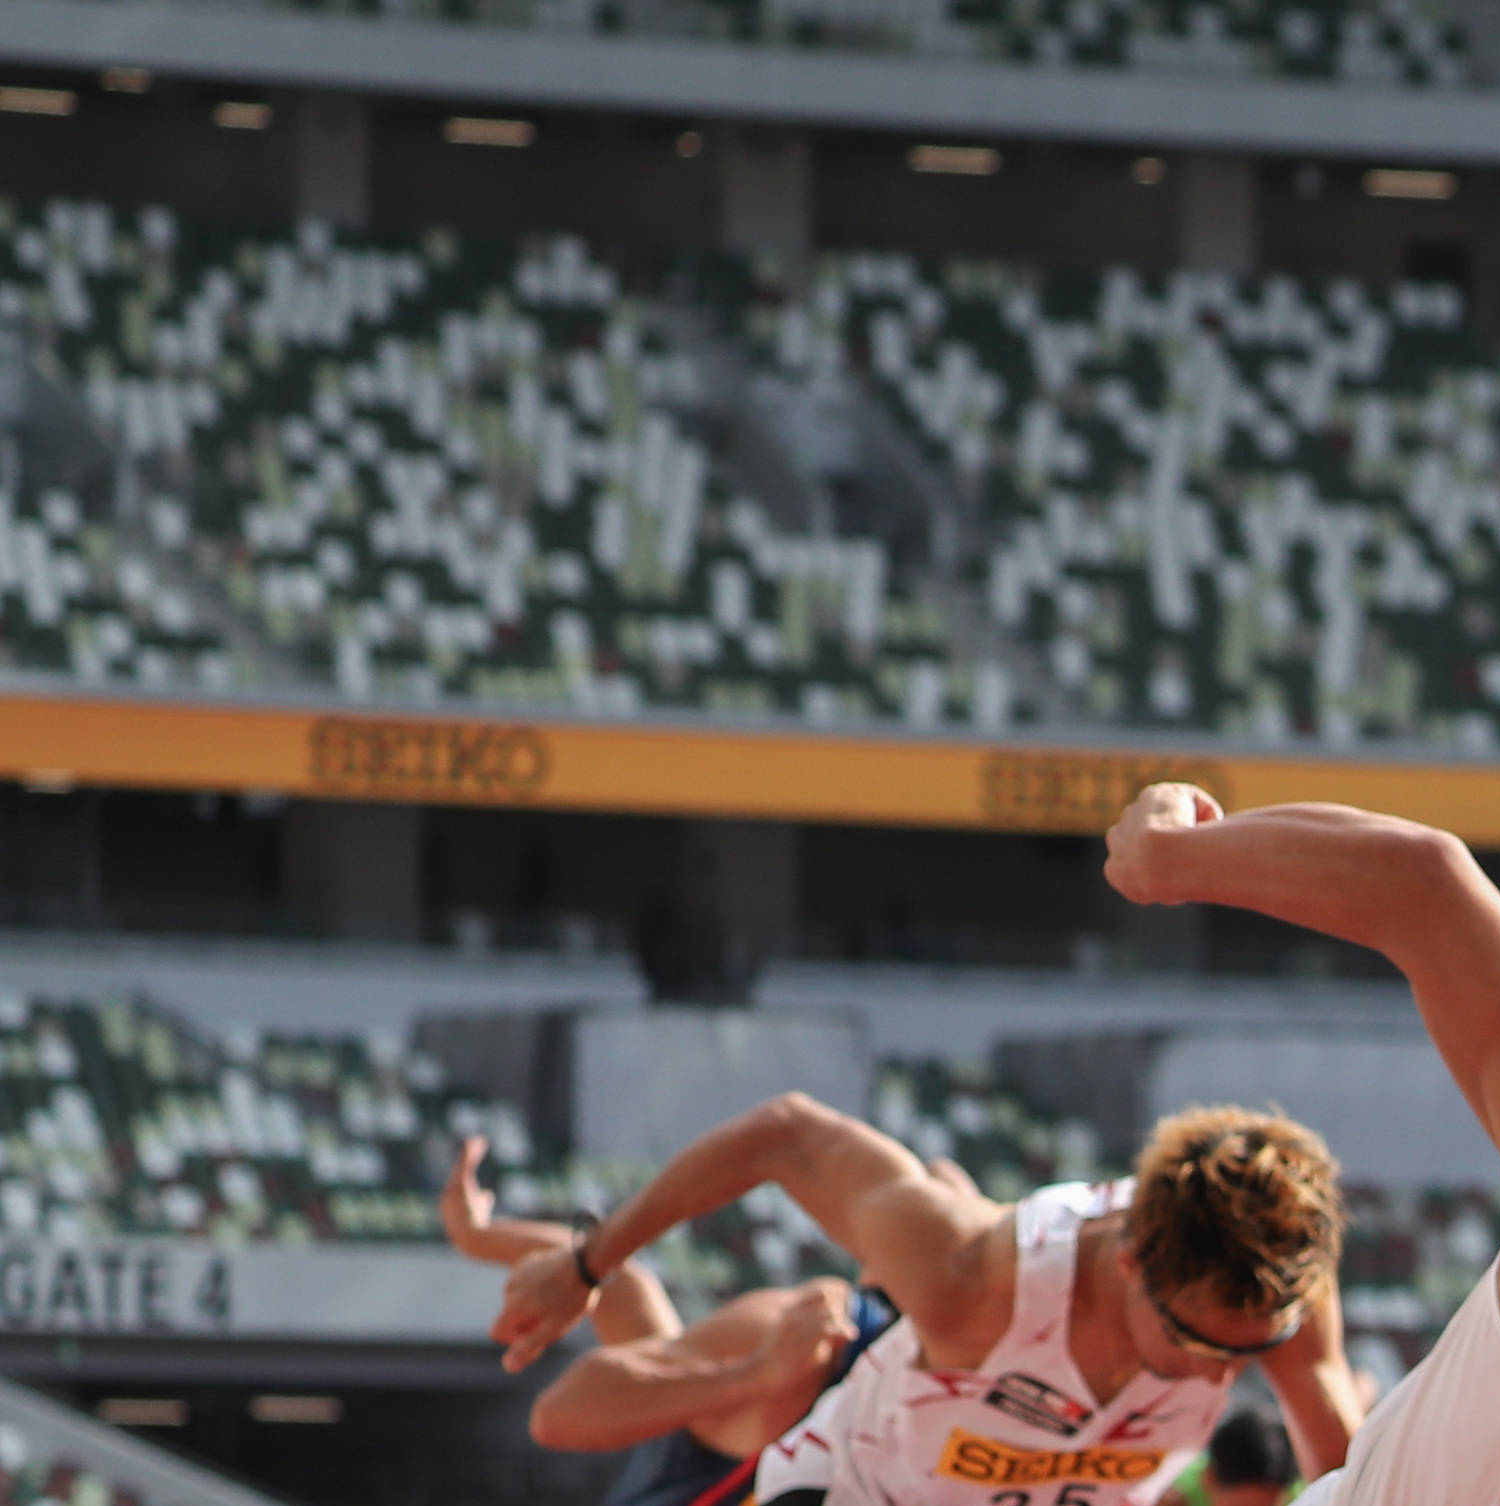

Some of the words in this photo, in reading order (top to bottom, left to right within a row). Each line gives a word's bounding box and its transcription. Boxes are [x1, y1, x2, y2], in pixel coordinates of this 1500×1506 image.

[308, 716, 553, 800] SEIKO
[0, 1247, 172, 1333] GATE
[196, 1254, 231, 1334] 4
